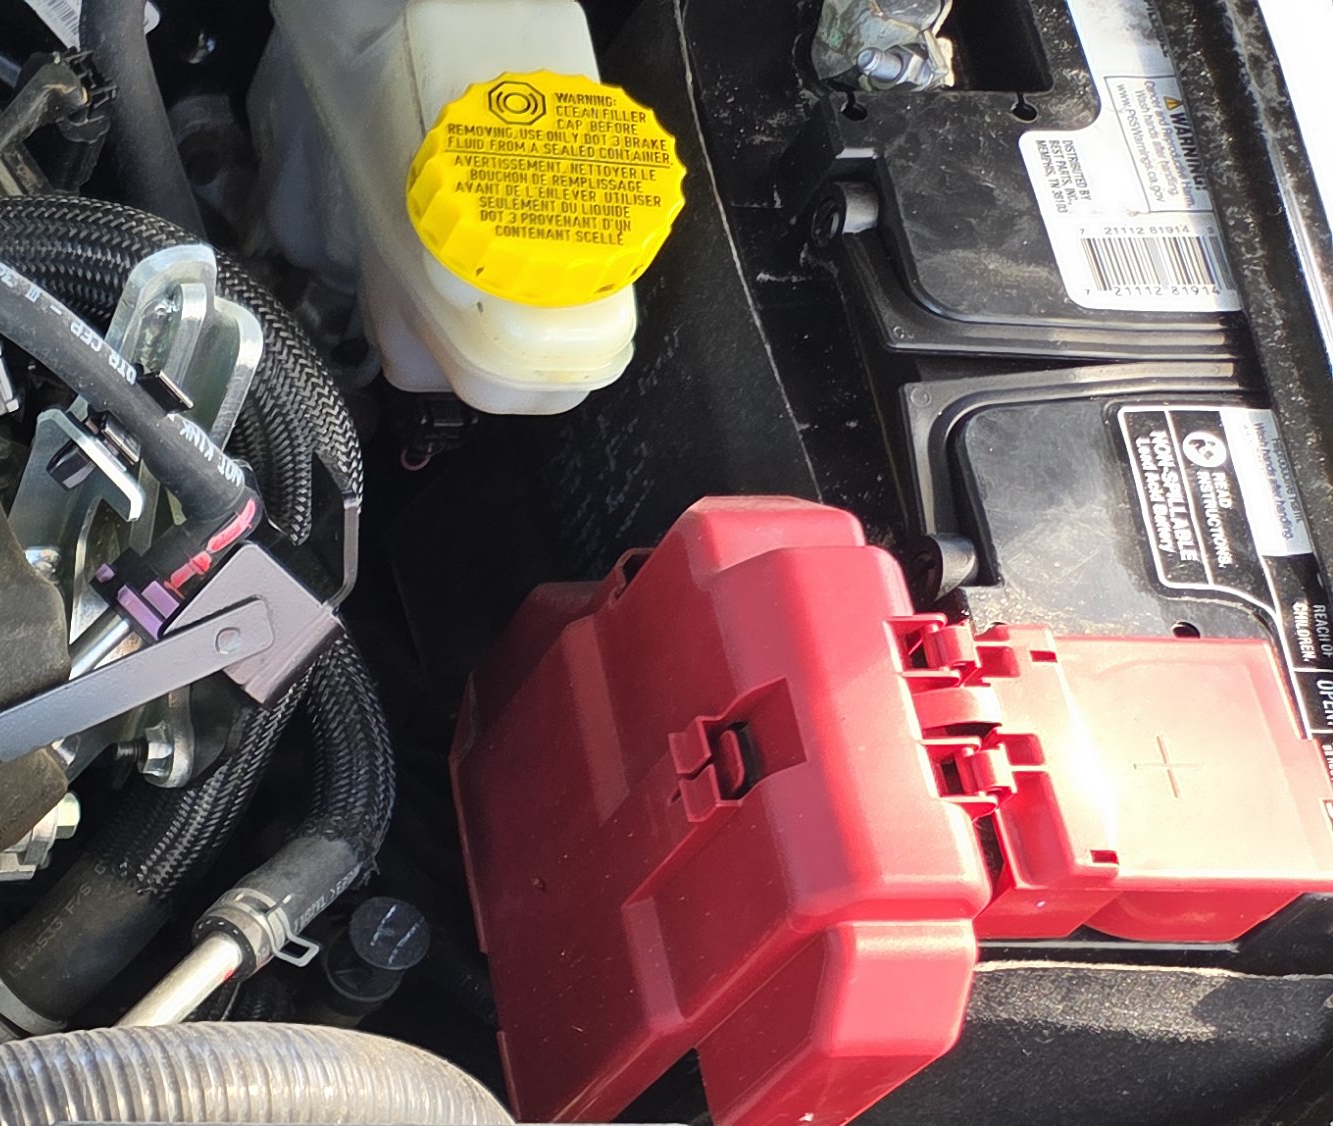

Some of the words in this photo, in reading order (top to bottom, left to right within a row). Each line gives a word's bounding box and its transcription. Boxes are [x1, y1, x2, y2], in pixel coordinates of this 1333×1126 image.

[554, 92, 617, 107] WARNING:
[556, 105, 599, 119] CLEAN
[602, 108, 647, 123] FILLER
[1135, 89, 1151, 116] Wash
[1143, 115, 1159, 140] hands
[1152, 140, 1167, 159] after
[1154, 110, 1170, 127] and
[556, 119, 582, 131] CAP
[590, 120, 638, 135] BEFORE
[447, 136, 485, 150] FLUID
[490, 139, 526, 152] FROM
[530, 142, 539, 153] A
[543, 143, 595, 158] SEALED
[599, 147, 674, 166] CONTAINER.
[519, 128, 544, 141] USE
[546, 130, 579, 143] ONLY
[584, 133, 607, 146] DOT
[612, 135, 620, 147] 3
[624, 136, 668, 151] BRAKE
[1048, 139, 1064, 158] BEST
[1161, 127, 1188, 180] Reproductive
[470, 168, 528, 184] BOUCHON
[532, 173, 547, 186] DE
[552, 174, 643, 193] REMPLISSAGE
[570, 163, 636, 179] NETTOYER
[641, 168, 657, 181] LE
[1062, 139, 1088, 188] DISTRIBUTED
[1079, 189, 1092, 200] BY
[454, 181, 500, 195] AVANT
[505, 184, 521, 197] DE
[604, 191, 662, 207] UTILISER
[1048, 178, 1061, 188] TN
[479, 196, 556, 212] SEULEMENT
[560, 201, 578, 214] DU
[581, 203, 631, 219] LIQUIDE
[480, 209, 505, 223] DOT
[508, 211, 517, 224] 3
[520, 212, 597, 230] PROVENANT
[495, 224, 571, 241] CONTENANT
[1103, 226, 1145, 235] 21112
[1148, 225, 1190, 235] 81914
[1113, 286, 1162, 296] 21112
[1171, 285, 1221, 296] 81914
[1254, 422, 1273, 449] Wash
[1135, 435, 1158, 471] Lead
[1261, 449, 1281, 478] hands
[1144, 471, 1166, 503] Acid
[1149, 429, 1201, 562] NON-SPILLABLE
[1211, 470, 1233, 510] READ
[1268, 478, 1286, 500] after
[1152, 503, 1177, 553] Battery
[1312, 603, 1329, 642] REACH
